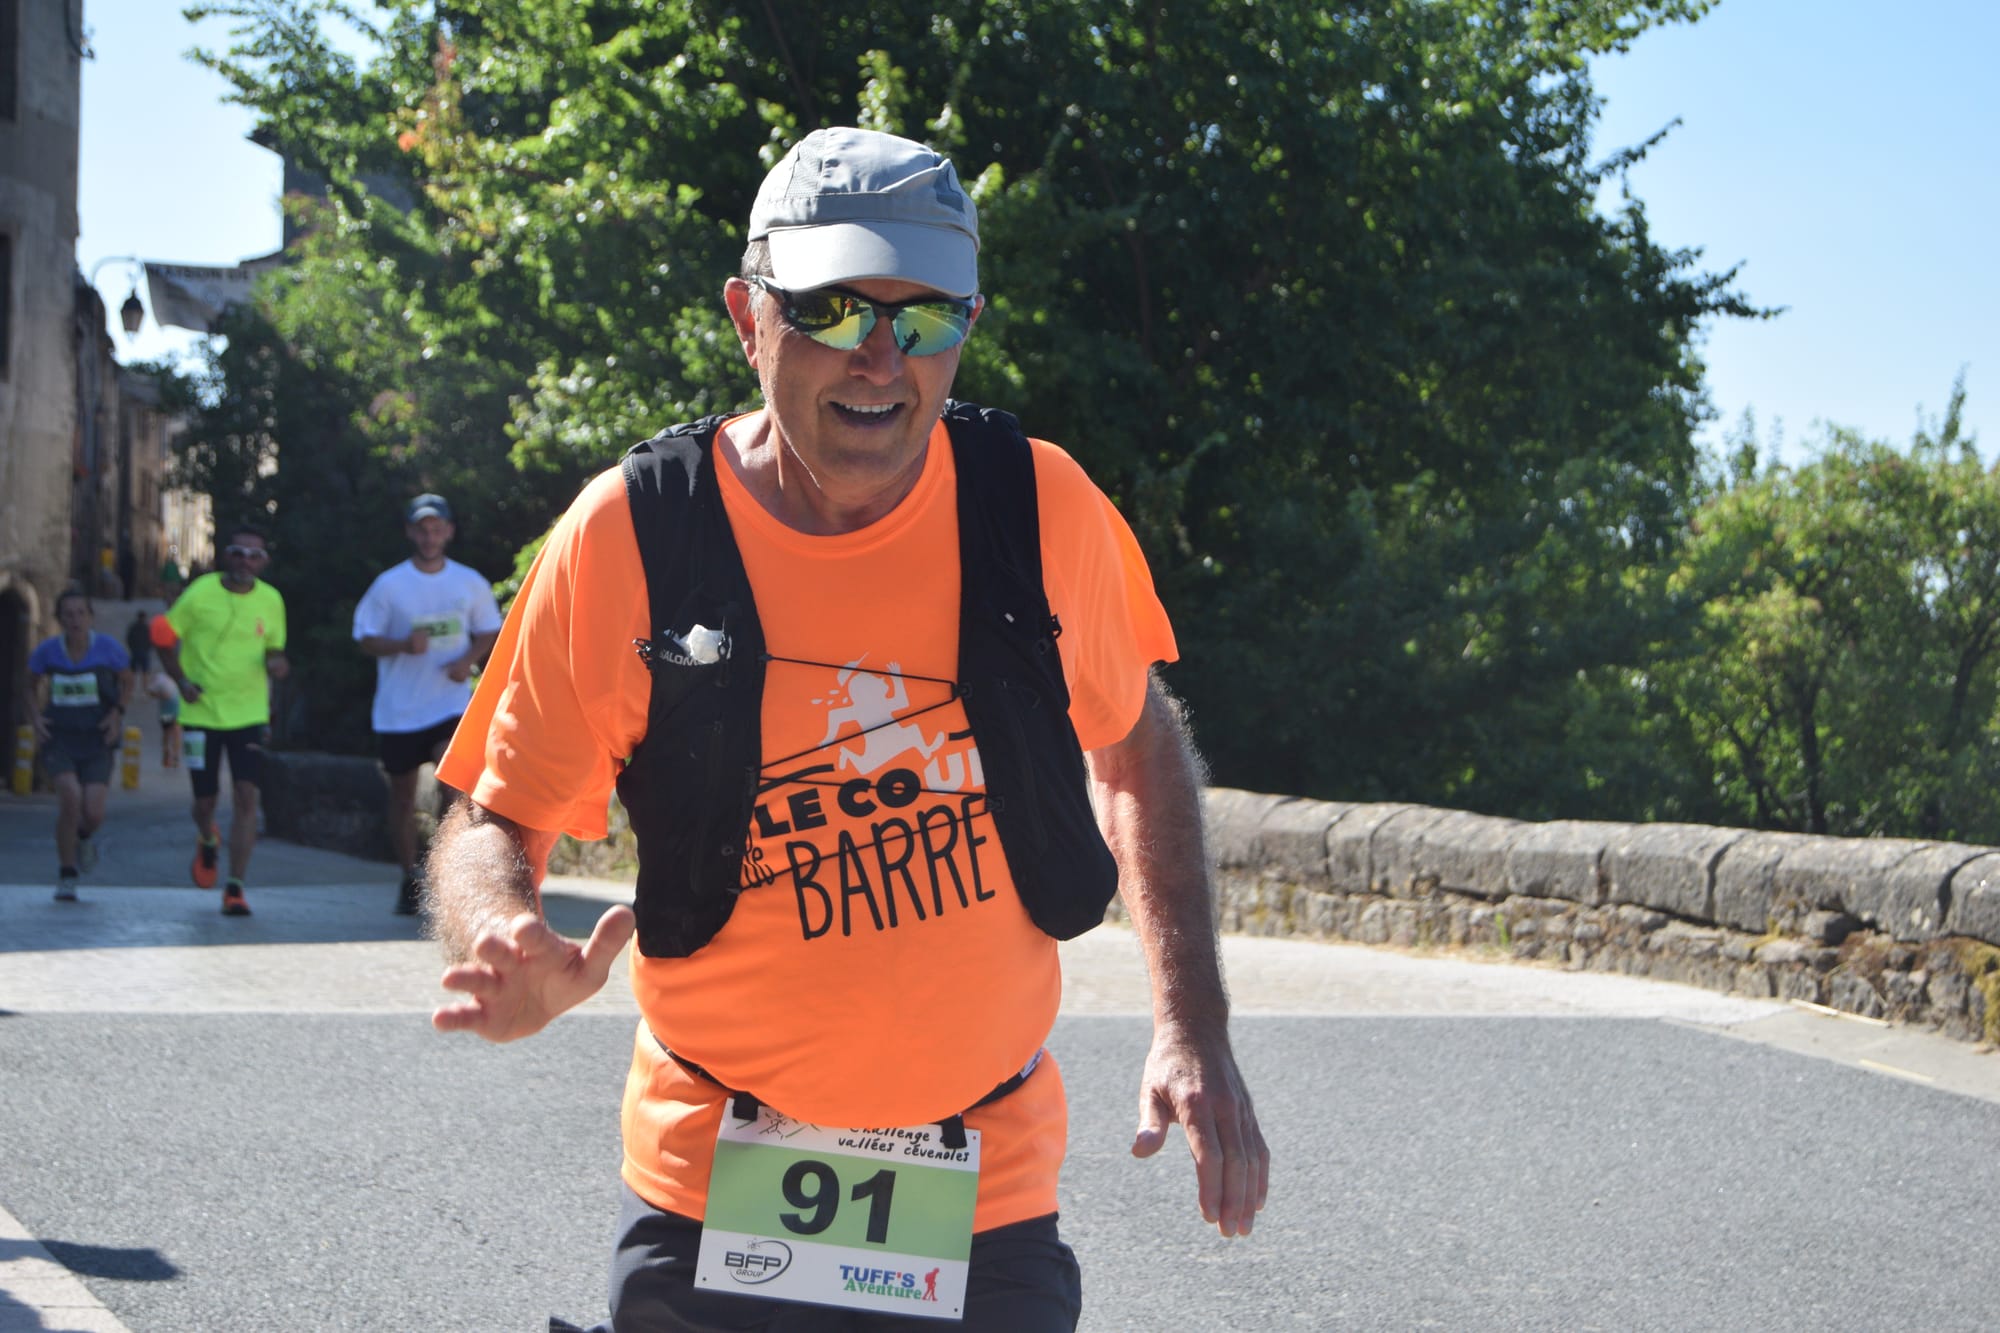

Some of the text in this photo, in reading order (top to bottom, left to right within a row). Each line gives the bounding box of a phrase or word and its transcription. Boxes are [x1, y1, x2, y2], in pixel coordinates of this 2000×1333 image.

[660, 648, 704, 666] SALOM
[785, 794, 996, 941] BARRE
[838, 1137, 970, 1162] vallées cévenoles
[779, 1160, 896, 1244] 91
[724, 1251, 782, 1272] BFP
[735, 1269, 764, 1278] GROUP
[839, 1264, 916, 1289] TUFF'S
[843, 1278, 923, 1300] Aventure
